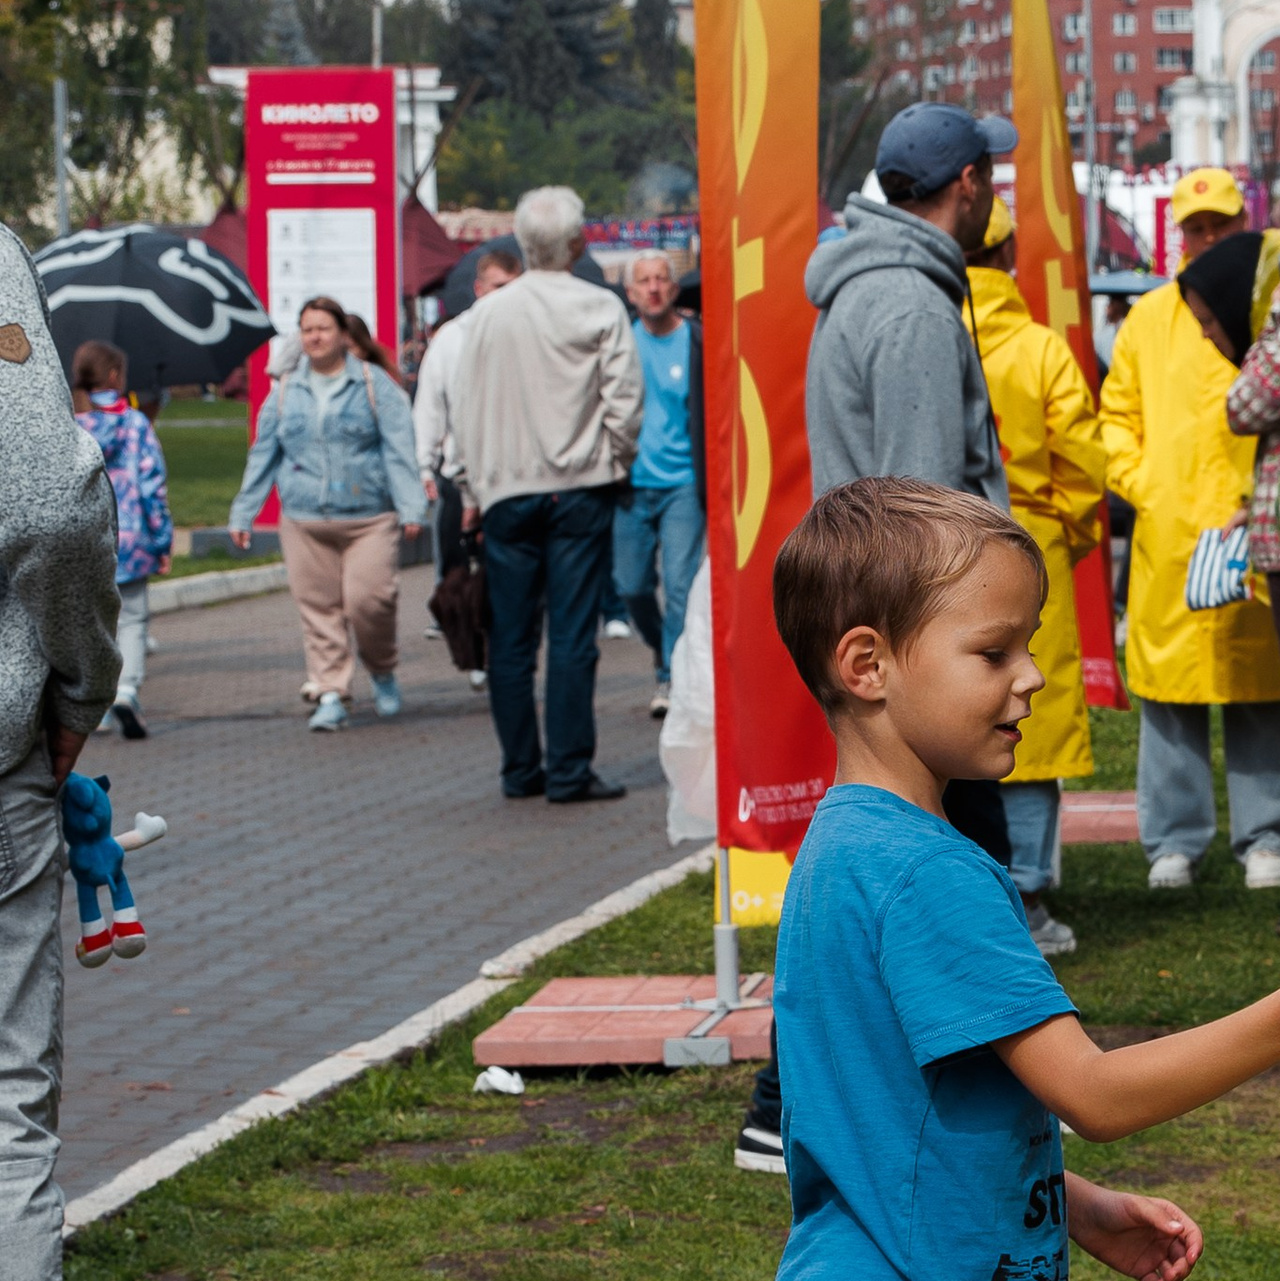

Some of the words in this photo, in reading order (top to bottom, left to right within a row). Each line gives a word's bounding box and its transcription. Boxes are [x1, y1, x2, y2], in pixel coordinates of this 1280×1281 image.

[261, 102, 379, 124] КИНОЛЕТО
[732, 890, 765, 912] 0+
[1023, 1171, 1067, 1229] ST
